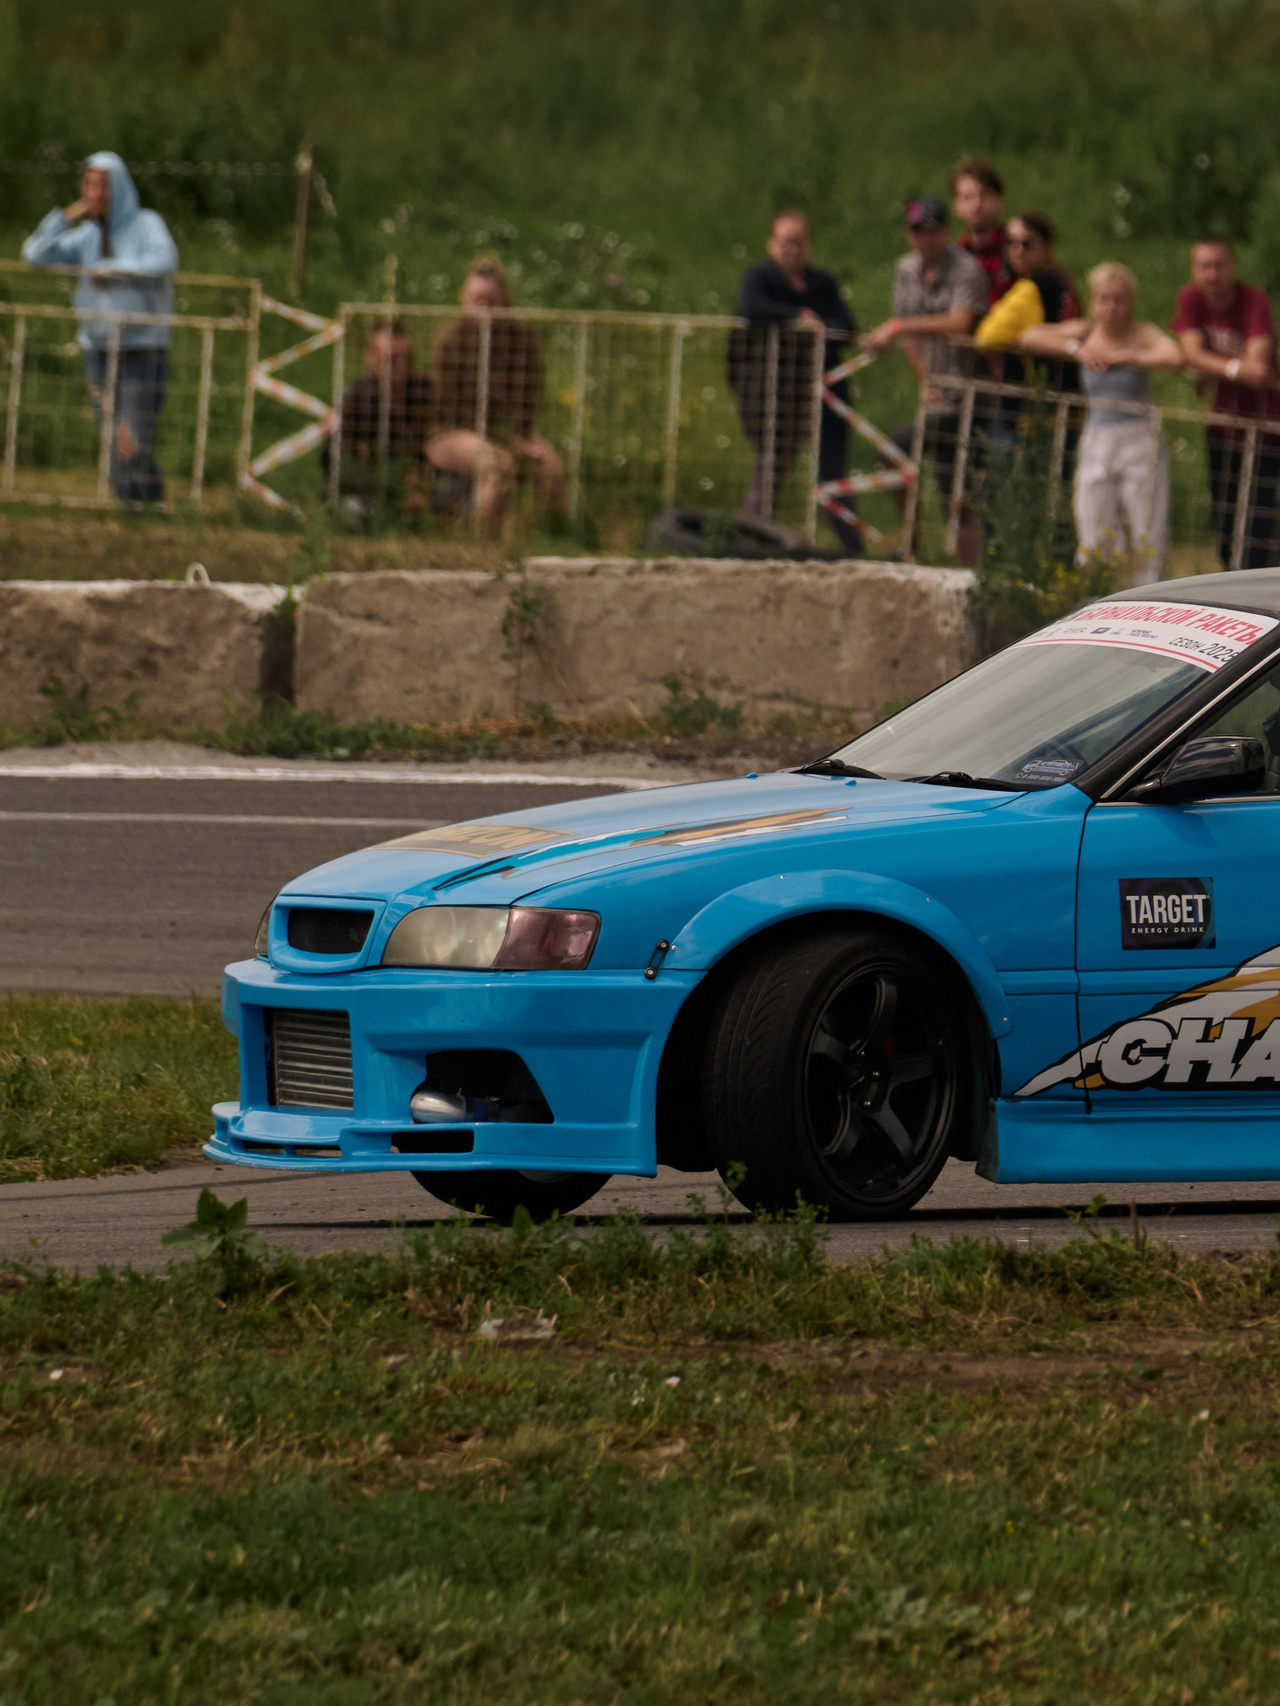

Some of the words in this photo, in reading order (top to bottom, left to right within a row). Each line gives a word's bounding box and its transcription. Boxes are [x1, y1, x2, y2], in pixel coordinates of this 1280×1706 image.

[1168, 637, 1205, 651] СЕЗОН
[1198, 642, 1240, 663] 2025
[1126, 894, 1206, 924] TARGET
